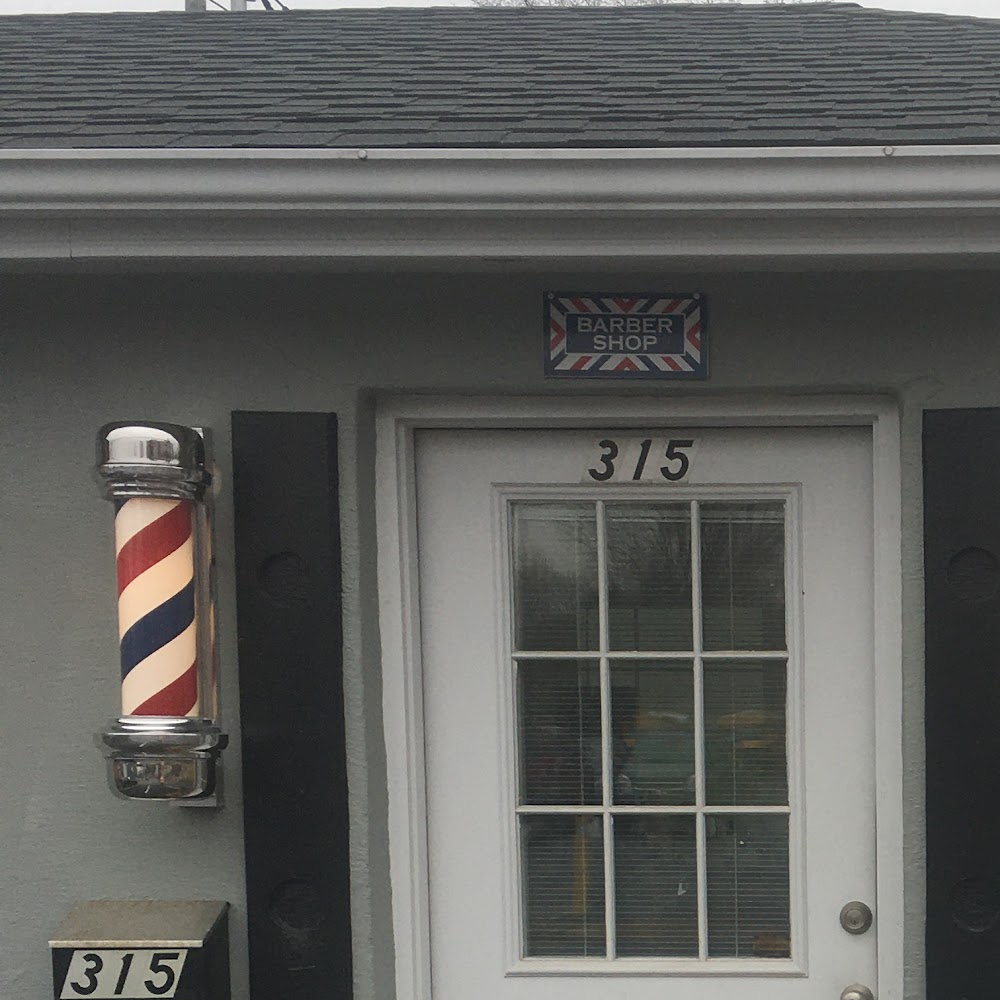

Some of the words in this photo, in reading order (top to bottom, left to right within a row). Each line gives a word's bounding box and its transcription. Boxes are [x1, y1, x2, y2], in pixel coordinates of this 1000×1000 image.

[577, 317, 673, 334] BARBER
[593, 335, 658, 351] SHOP
[587, 439, 694, 481] 315
[70, 953, 179, 995] 315
